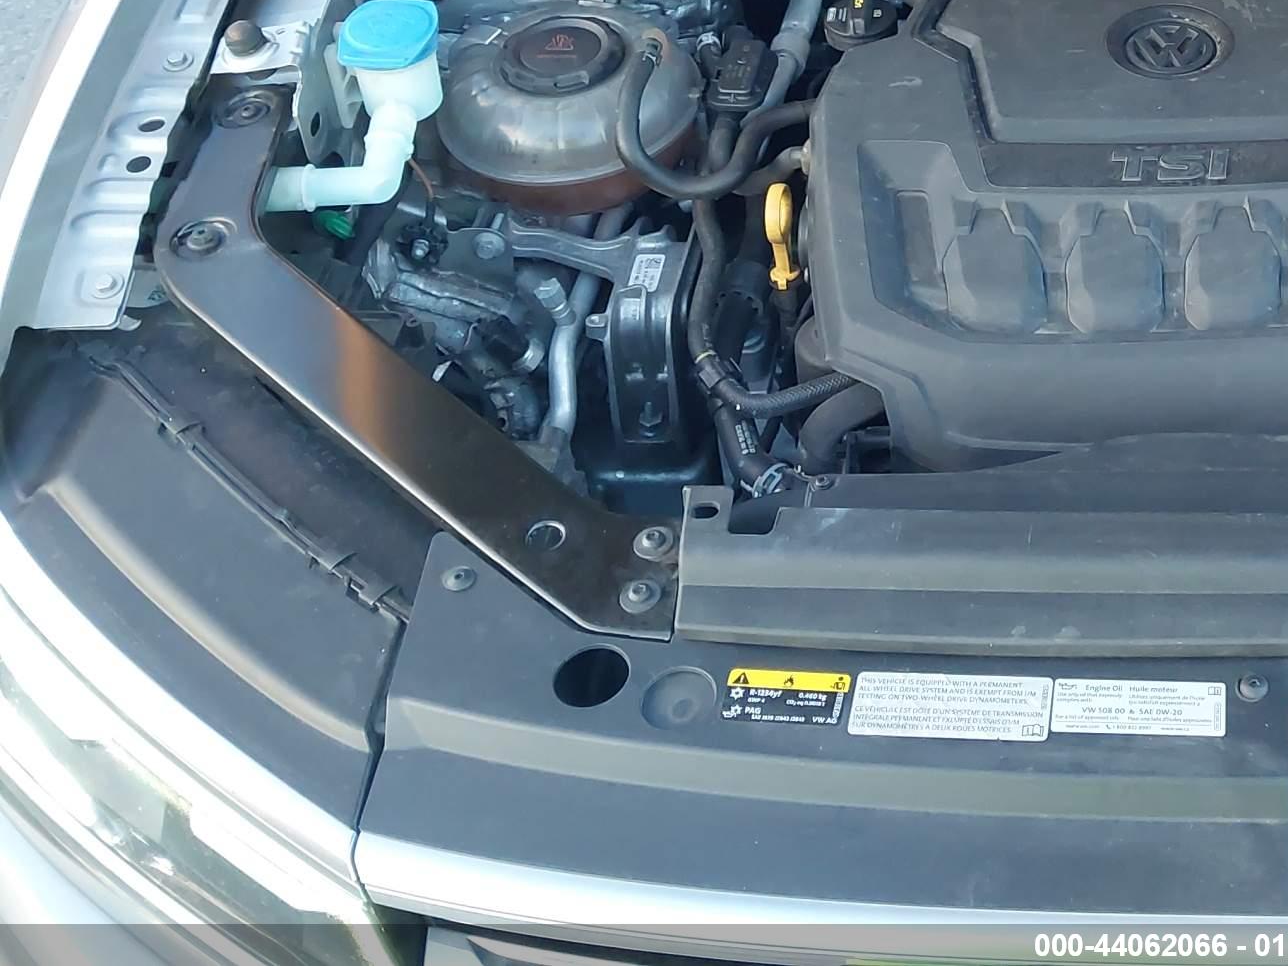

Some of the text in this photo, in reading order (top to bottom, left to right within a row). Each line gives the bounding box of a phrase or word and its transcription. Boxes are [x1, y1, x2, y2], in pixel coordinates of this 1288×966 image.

[1112, 148, 1230, 181] TSI
[1085, 684, 1111, 693] Engine
[1112, 684, 1123, 692] Oil
[1150, 686, 1178, 694] moteur
[749, 689, 783, 699] R-1234yf
[816, 693, 828, 701] kg
[857, 692, 887, 700] TESTING
[744, 706, 762, 715] PAG
